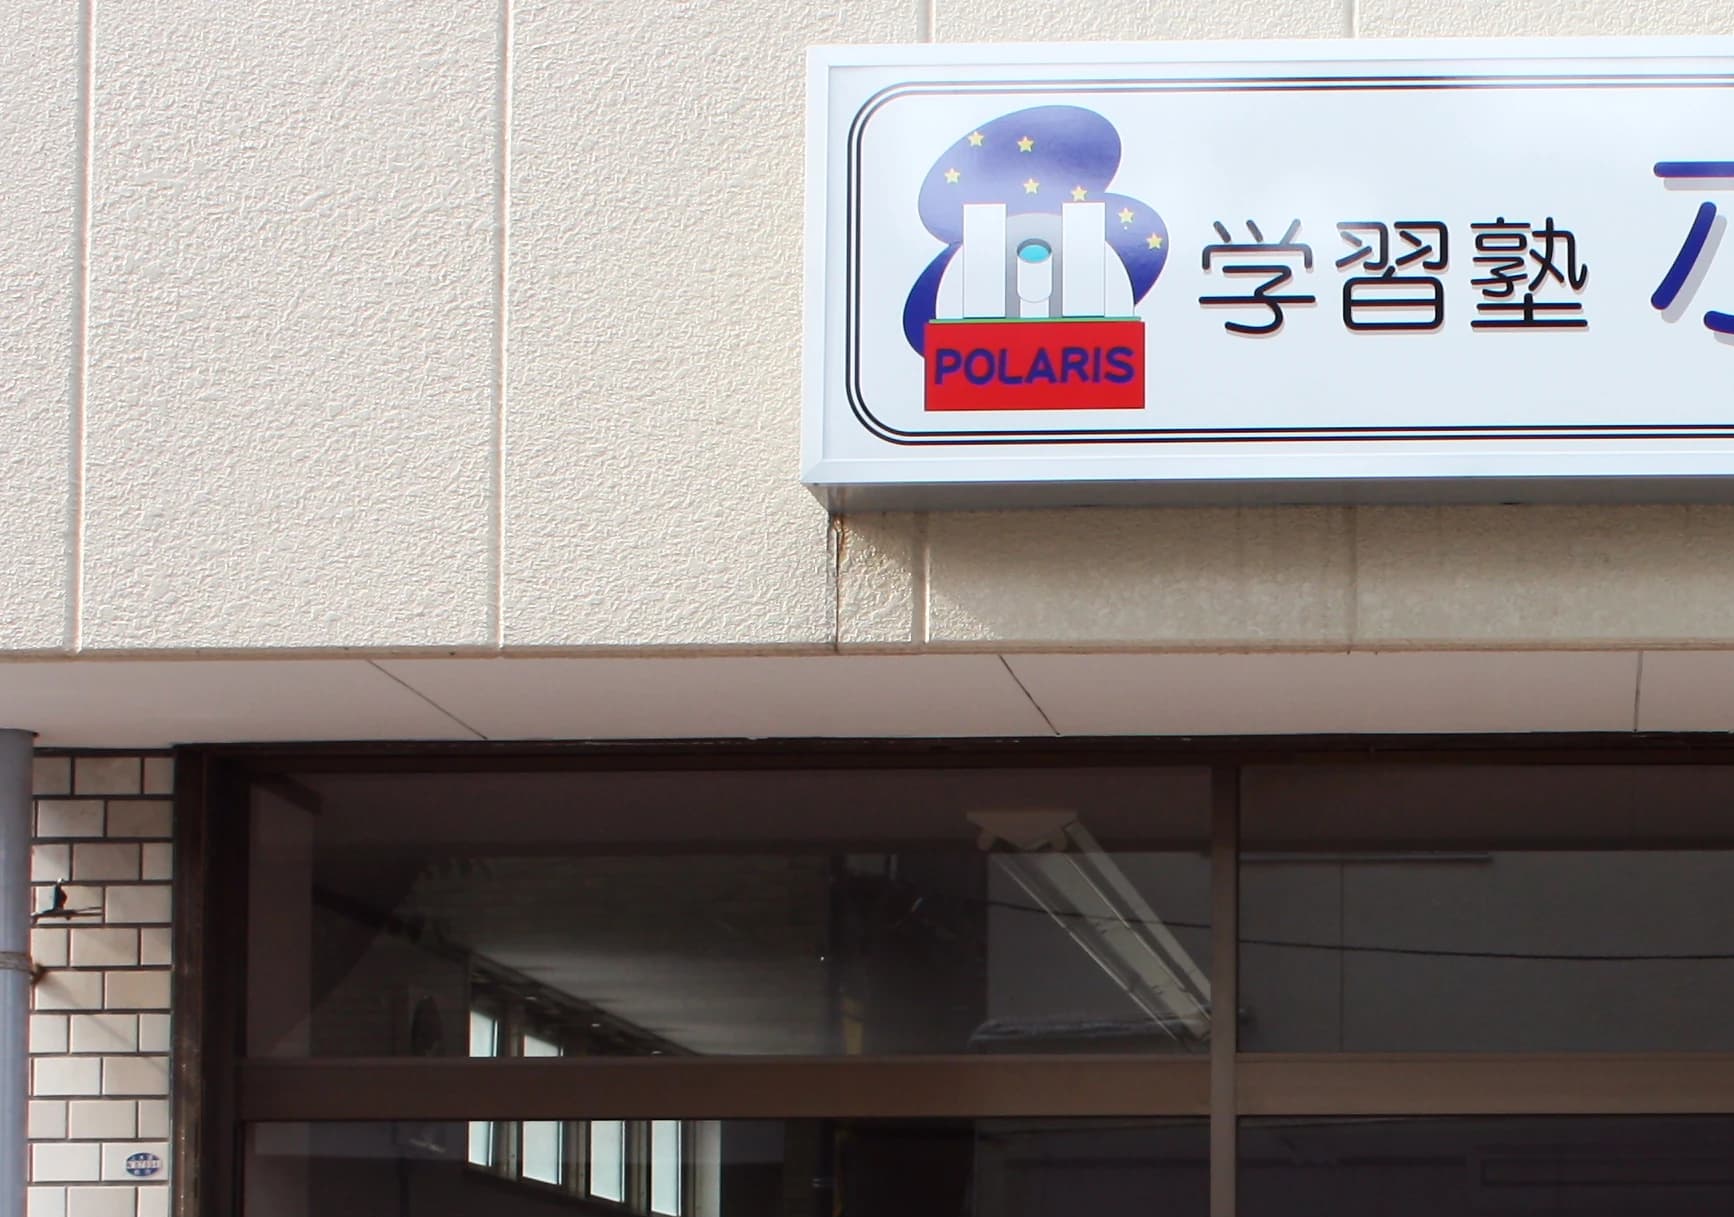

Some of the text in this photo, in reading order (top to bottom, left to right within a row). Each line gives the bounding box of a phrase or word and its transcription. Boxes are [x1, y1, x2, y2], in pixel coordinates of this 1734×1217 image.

[1198, 217, 1590, 336] 学習塾
[933, 343, 1137, 387] POLARIS
